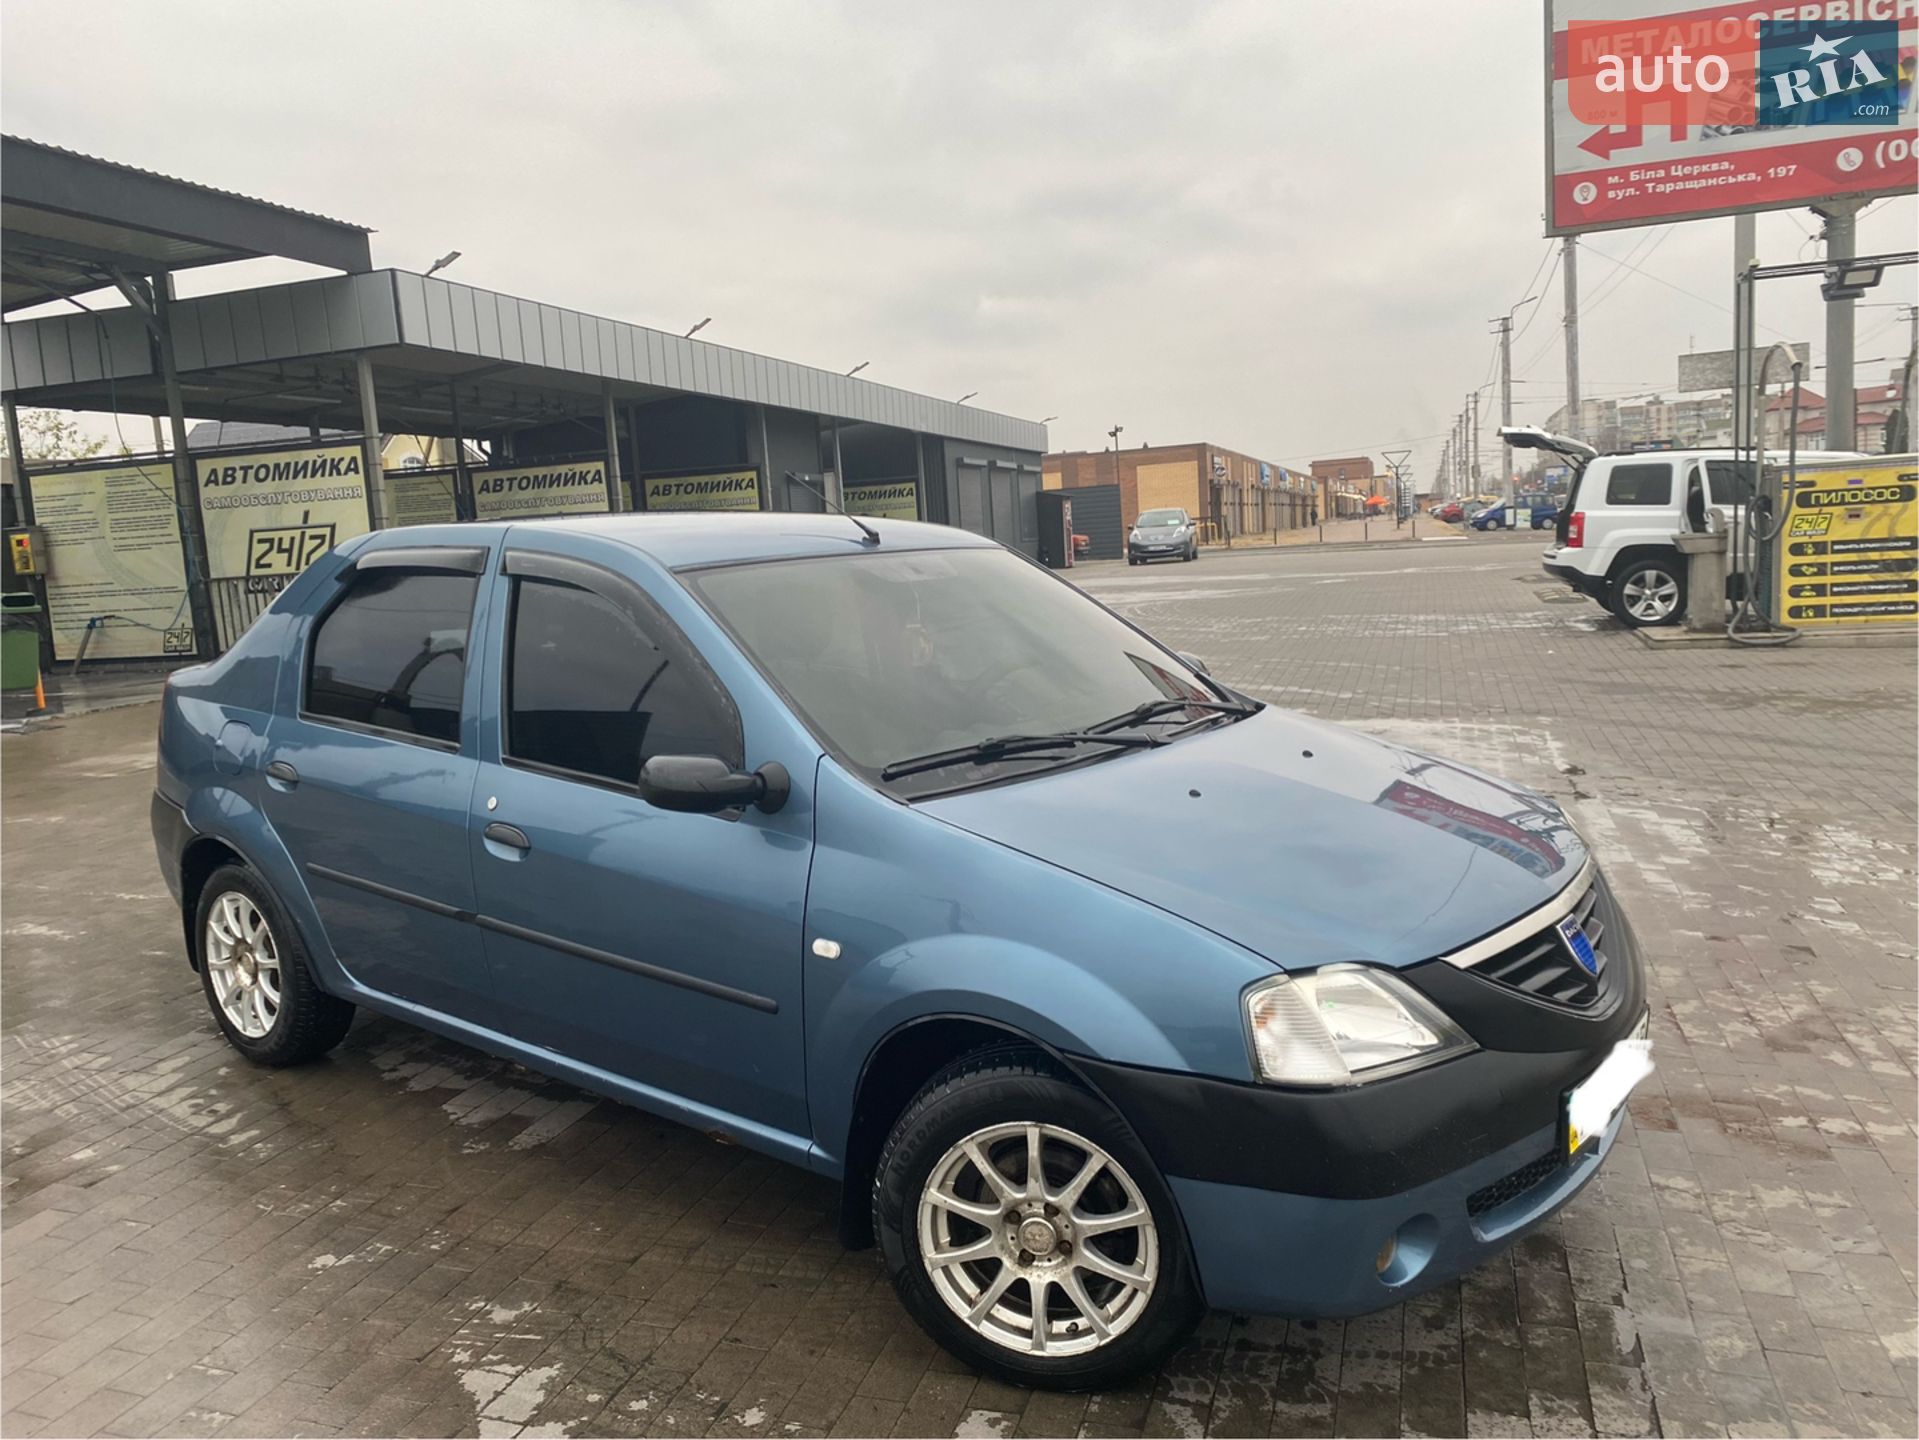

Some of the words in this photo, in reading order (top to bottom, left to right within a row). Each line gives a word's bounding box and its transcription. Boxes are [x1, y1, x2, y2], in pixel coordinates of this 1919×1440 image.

[1607, 175, 1624, 185] м.
[1629, 169, 1666, 182] Біла
[1670, 161, 1735, 177] Церква,
[1607, 188, 1641, 200] вул.
[1645, 171, 1763, 194] Таращанська,
[1766, 165, 1798, 179] 197
[203, 454, 360, 487] АВТОМИЙКА
[477, 468, 603, 495] АВТОМИЙКА
[203, 486, 362, 509] САМООБСЛУГОВУВАННЯ
[650, 477, 755, 497] АВТОМИЙКА
[843, 487, 915, 502] ВТОМИЙКА
[1811, 488, 1900, 505] ПИЛОСОС
[478, 492, 605, 512] САМООБСЛУГОВУВАННЯ
